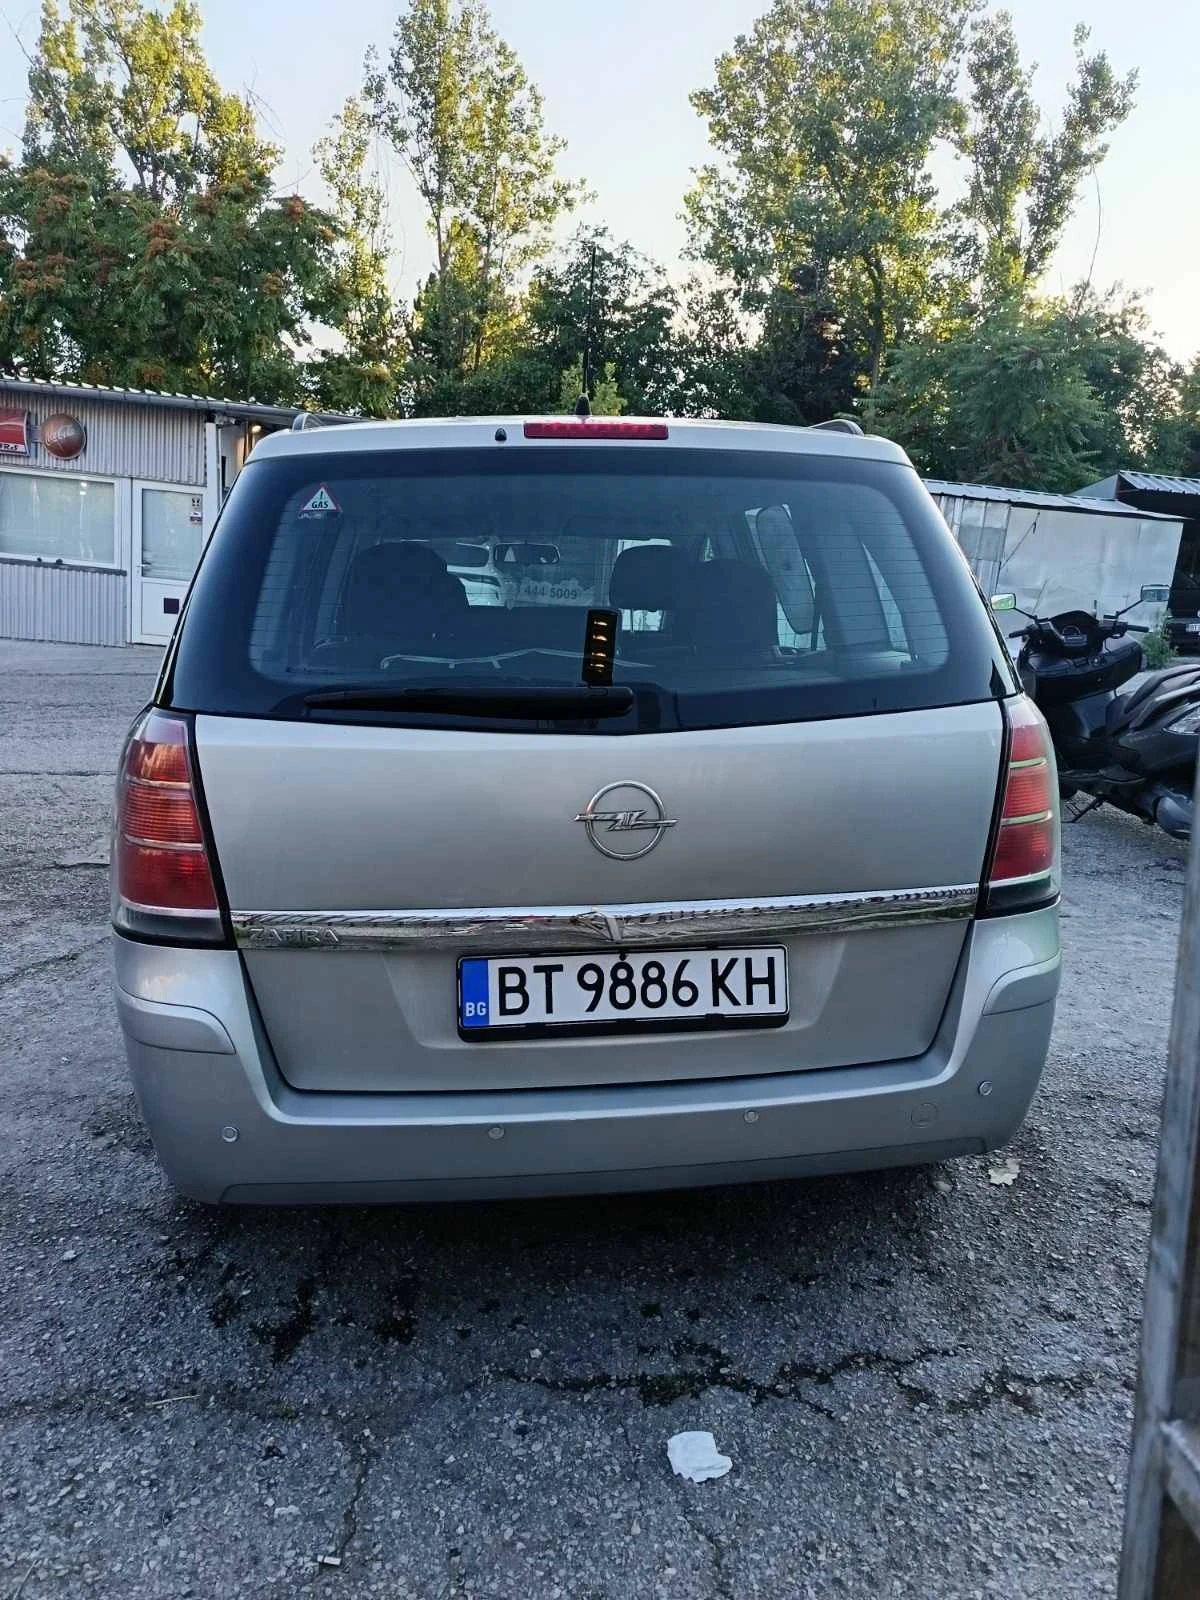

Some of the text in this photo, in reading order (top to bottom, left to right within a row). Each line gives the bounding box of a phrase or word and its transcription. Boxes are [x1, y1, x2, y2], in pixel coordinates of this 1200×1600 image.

[311, 500, 329, 509] GAS
[249, 927, 339, 942] ZAFIRA
[498, 956, 777, 1017] BT 9886 KH
[465, 1002, 487, 1017] BG
